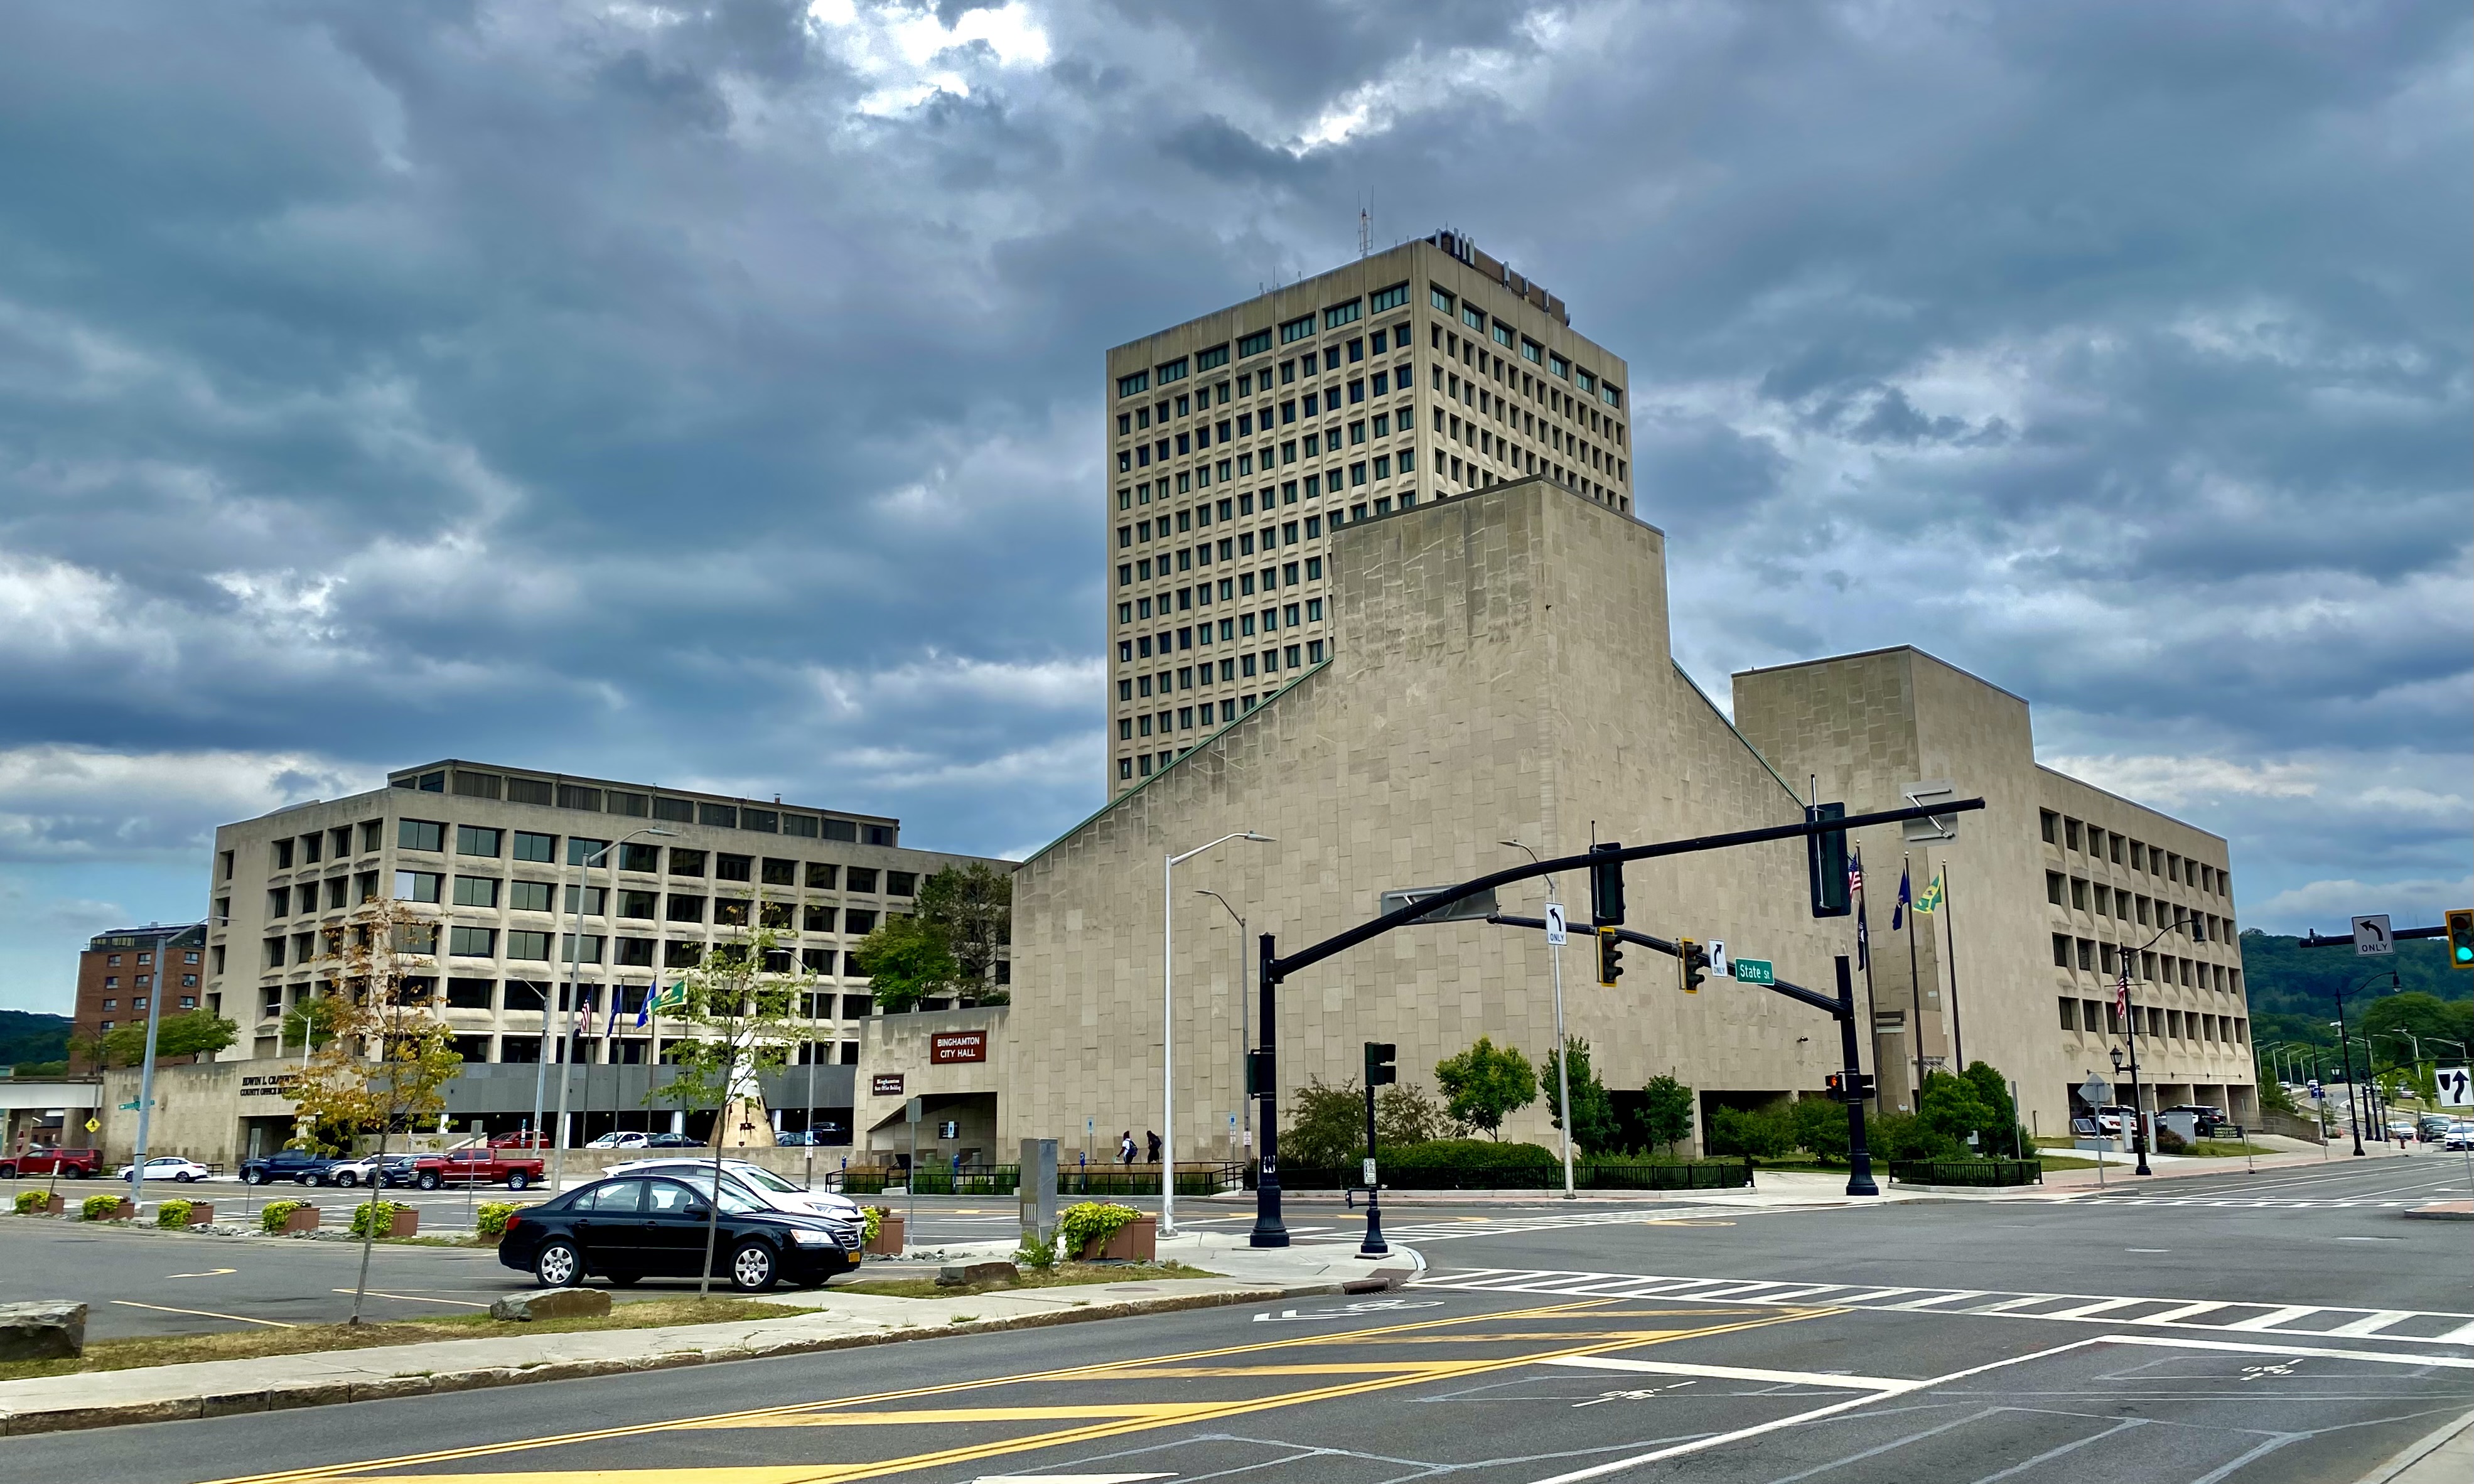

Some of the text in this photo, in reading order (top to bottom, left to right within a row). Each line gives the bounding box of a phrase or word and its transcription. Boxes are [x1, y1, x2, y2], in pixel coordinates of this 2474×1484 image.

[1550, 933, 1564, 942] ONLY
[2362, 943, 2388, 952] ONLY
[1713, 966, 1725, 974] ONLY
[1740, 964, 1770, 979] State St
[937, 1036, 980, 1047] BINGHAMTON
[940, 1048, 976, 1058] CITY HALL
[241, 1077, 262, 1086] EDWIN
[240, 1088, 260, 1096] COUNTY
[260, 1087, 277, 1095] OFFICE
